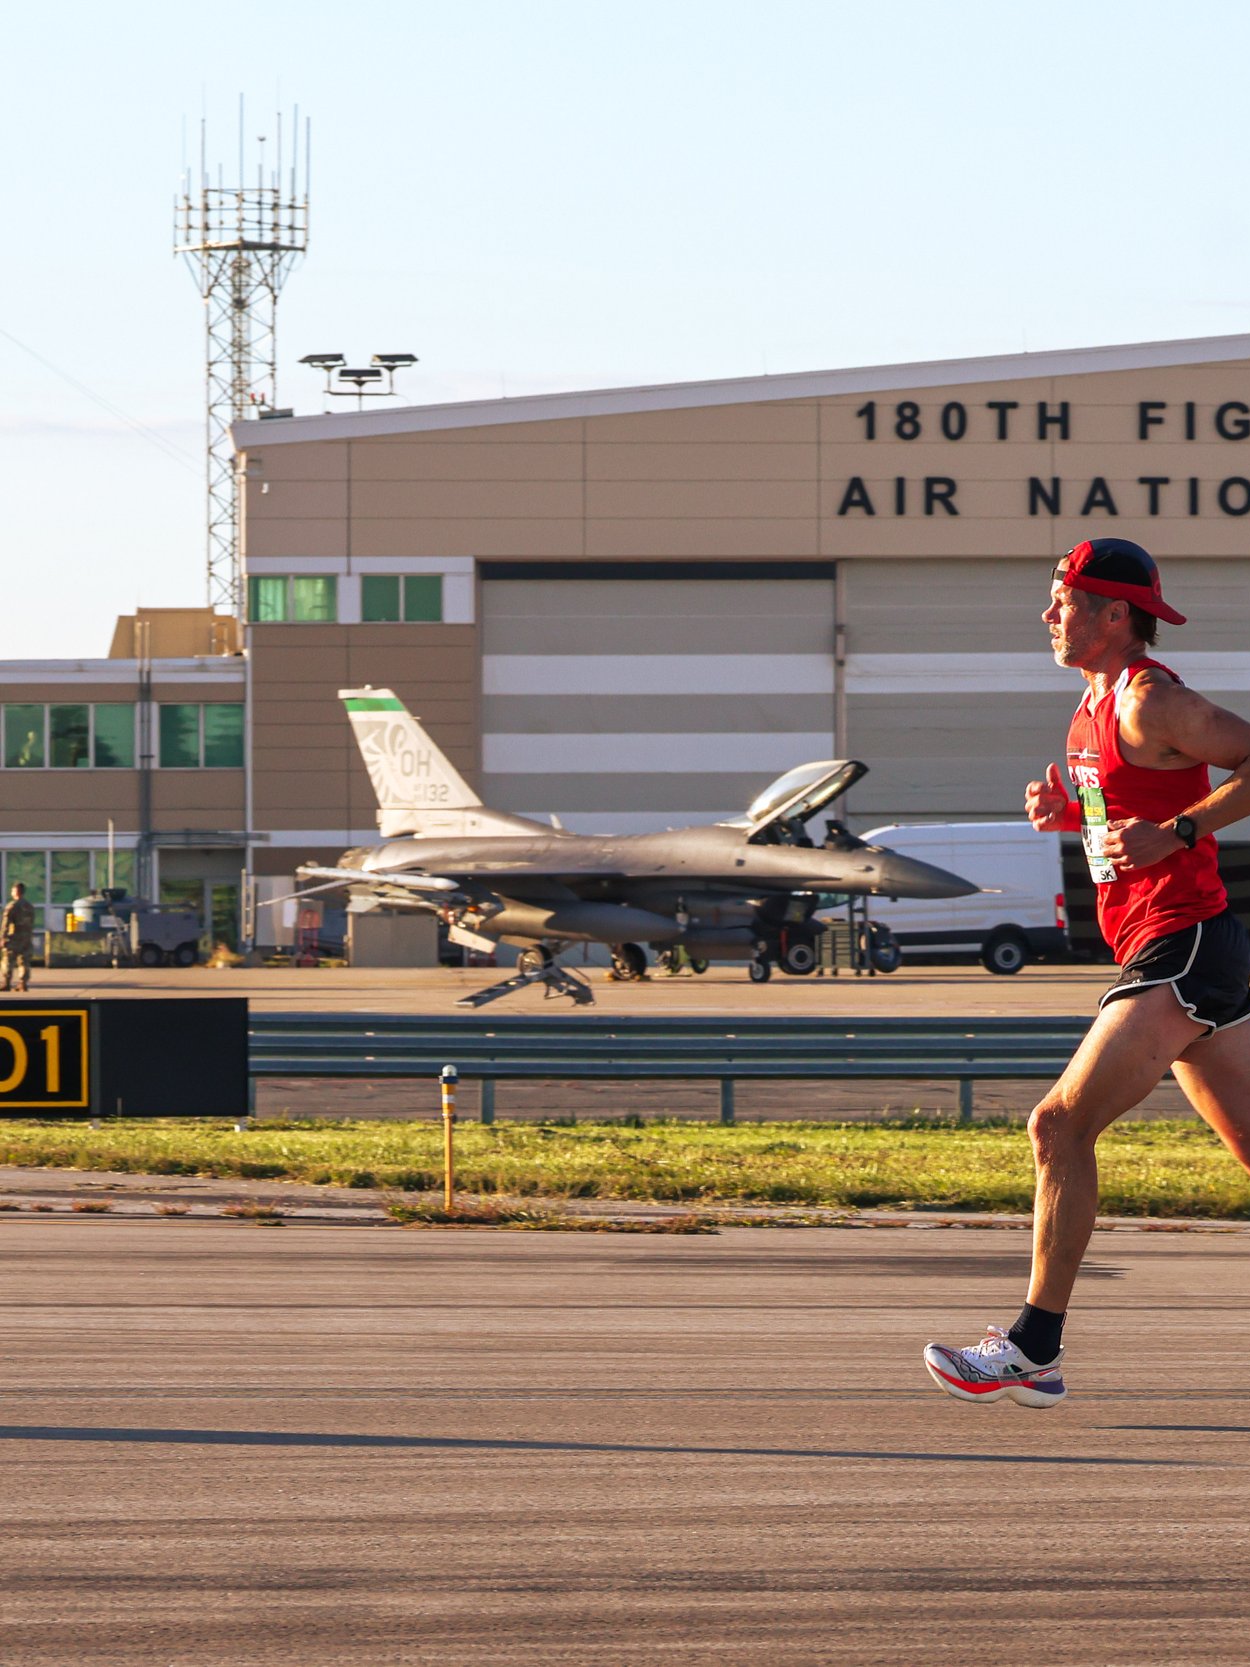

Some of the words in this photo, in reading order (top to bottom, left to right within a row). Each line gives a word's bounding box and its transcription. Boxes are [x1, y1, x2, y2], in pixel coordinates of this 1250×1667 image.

[857, 401, 1070, 441] 180TH
[837, 476, 959, 516] AIR
[401, 749, 432, 777] OH
[423, 783, 449, 802] 132
